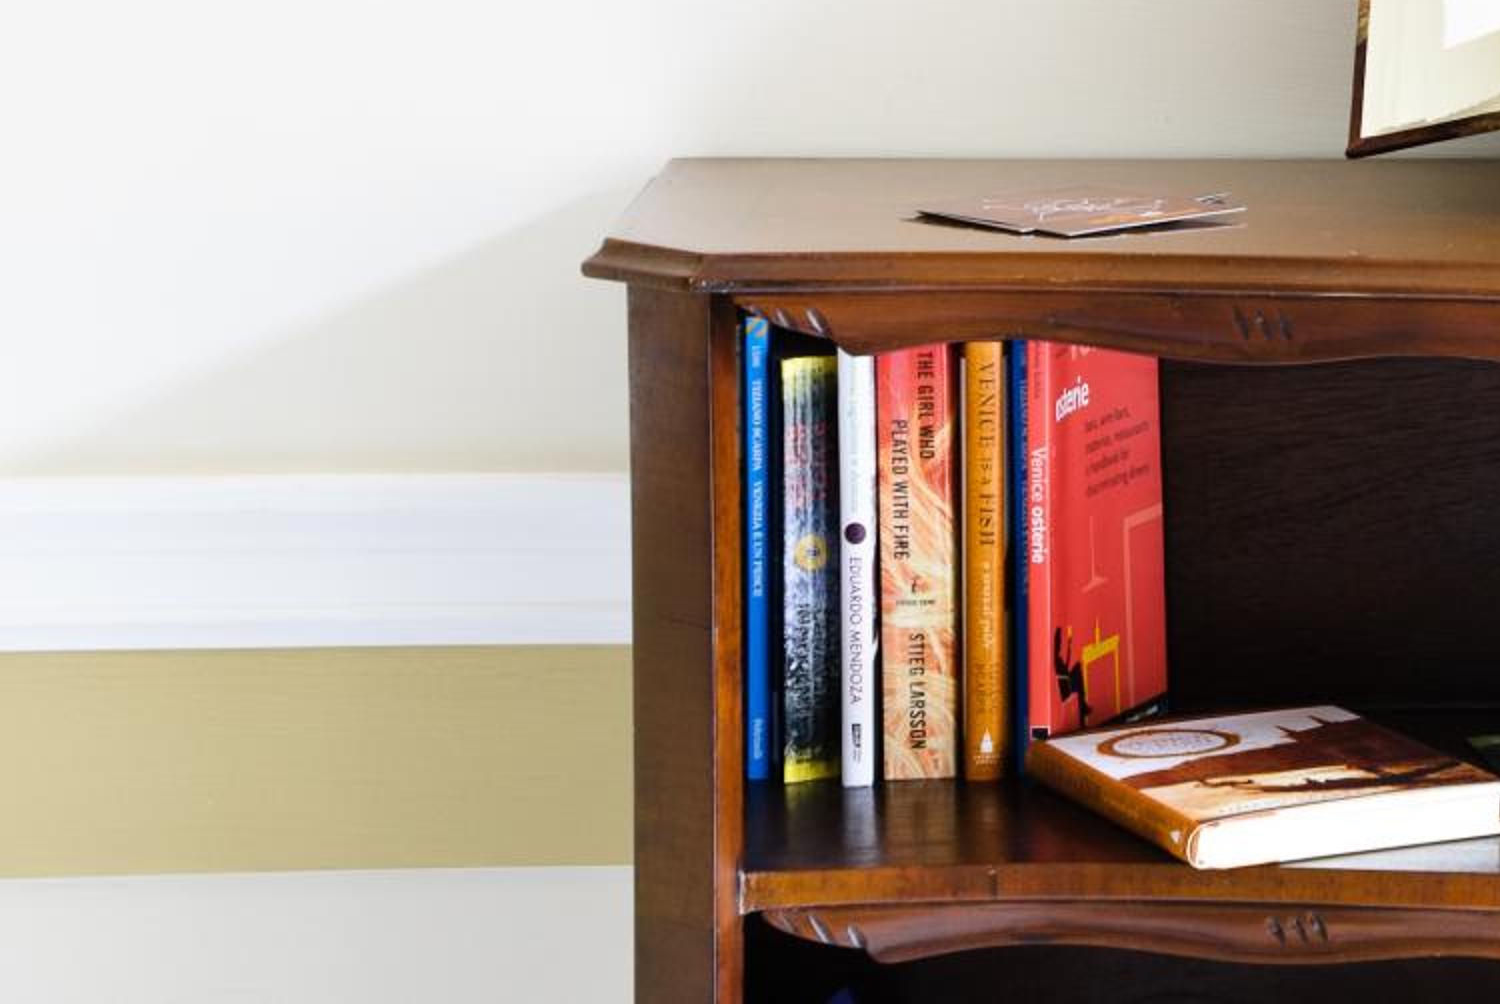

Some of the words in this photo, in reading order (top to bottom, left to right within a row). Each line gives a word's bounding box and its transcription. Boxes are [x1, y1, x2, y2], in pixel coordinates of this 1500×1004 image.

[916, 351, 933, 378] THE
[917, 385, 934, 420] GIRL
[978, 361, 996, 449] VENICE
[891, 419, 908, 475] PLAYED
[918, 425, 936, 459] WHO
[892, 480, 909, 519] WITH
[1031, 446, 1048, 501] Venice
[893, 525, 910, 559] FIRE
[978, 492, 996, 545] FISH
[1031, 506, 1047, 564] osterie
[848, 556, 863, 625] EDUARDO
[848, 630, 863, 705] MENDOZA
[908, 632, 925, 676] STIEG
[909, 681, 927, 749] LARSSON
